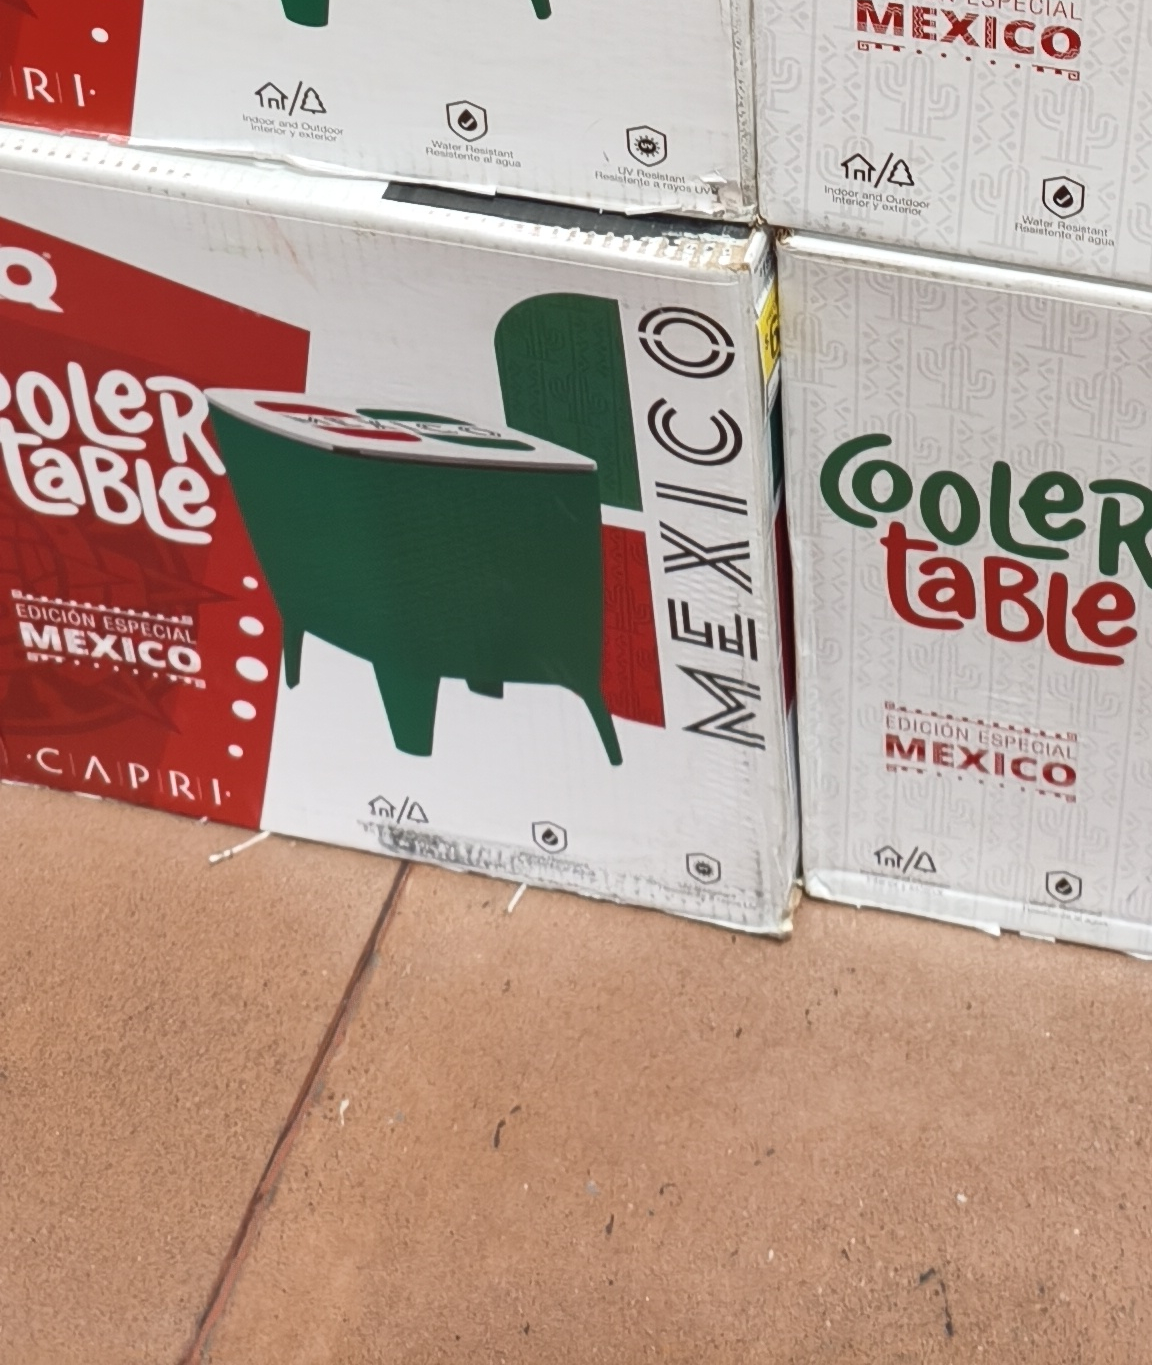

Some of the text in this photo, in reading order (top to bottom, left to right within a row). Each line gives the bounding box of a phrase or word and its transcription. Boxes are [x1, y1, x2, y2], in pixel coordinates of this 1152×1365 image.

[824, 185, 930, 209] Indoor and Outdoor
[832, 194, 922, 216] Interior exterior
[1014, 222, 1114, 247] Resistente agua
[1022, 215, 1108, 237] Water Resistant
[637, 306, 766, 750] MEXICO
[15, 603, 196, 644] EDICIÓN ESPECIAL
[19, 621, 201, 674] MEXICO
[886, 714, 1077, 761] EDICIÓN ESPECIAL
[885, 734, 1077, 788] MEXICO
